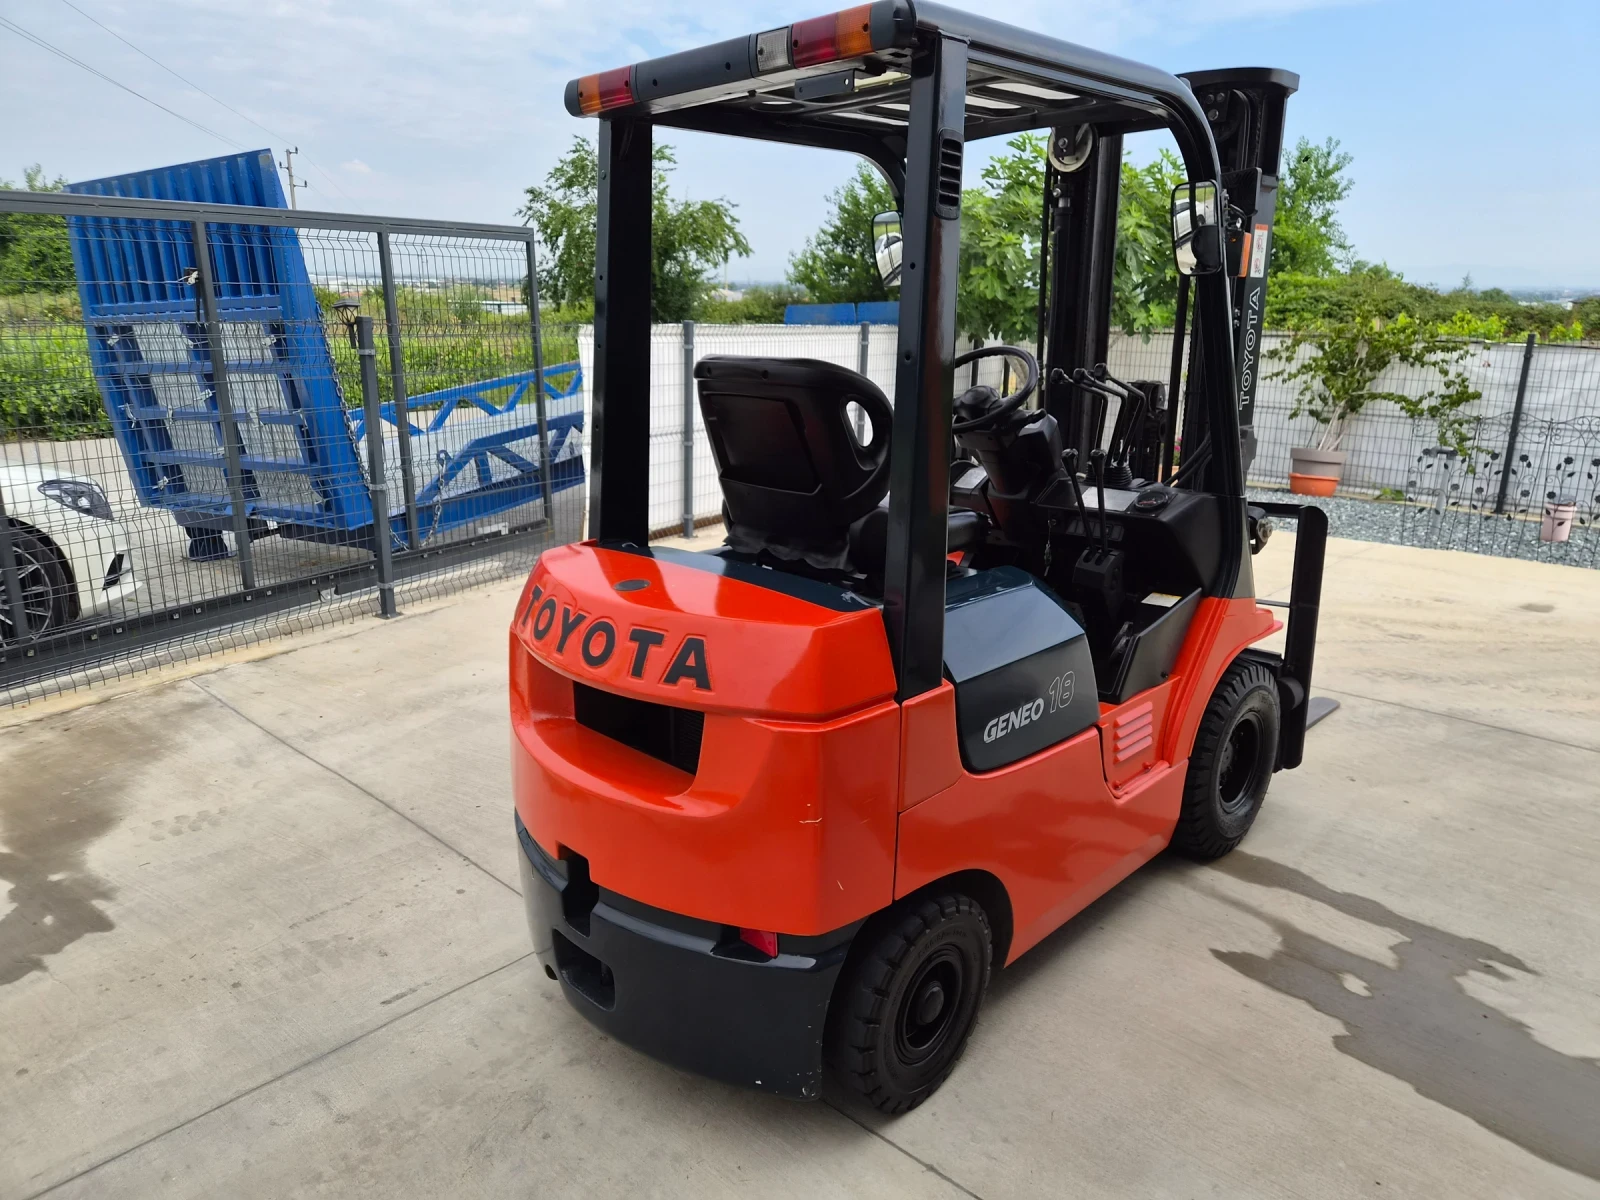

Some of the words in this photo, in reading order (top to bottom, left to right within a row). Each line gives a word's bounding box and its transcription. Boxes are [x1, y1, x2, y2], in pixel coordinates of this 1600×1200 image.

[1239, 286, 1261, 410] TOYOTA
[522, 584, 712, 691] TOYOTA
[983, 697, 1045, 744] GENEO
[1048, 670, 1076, 714] 18
